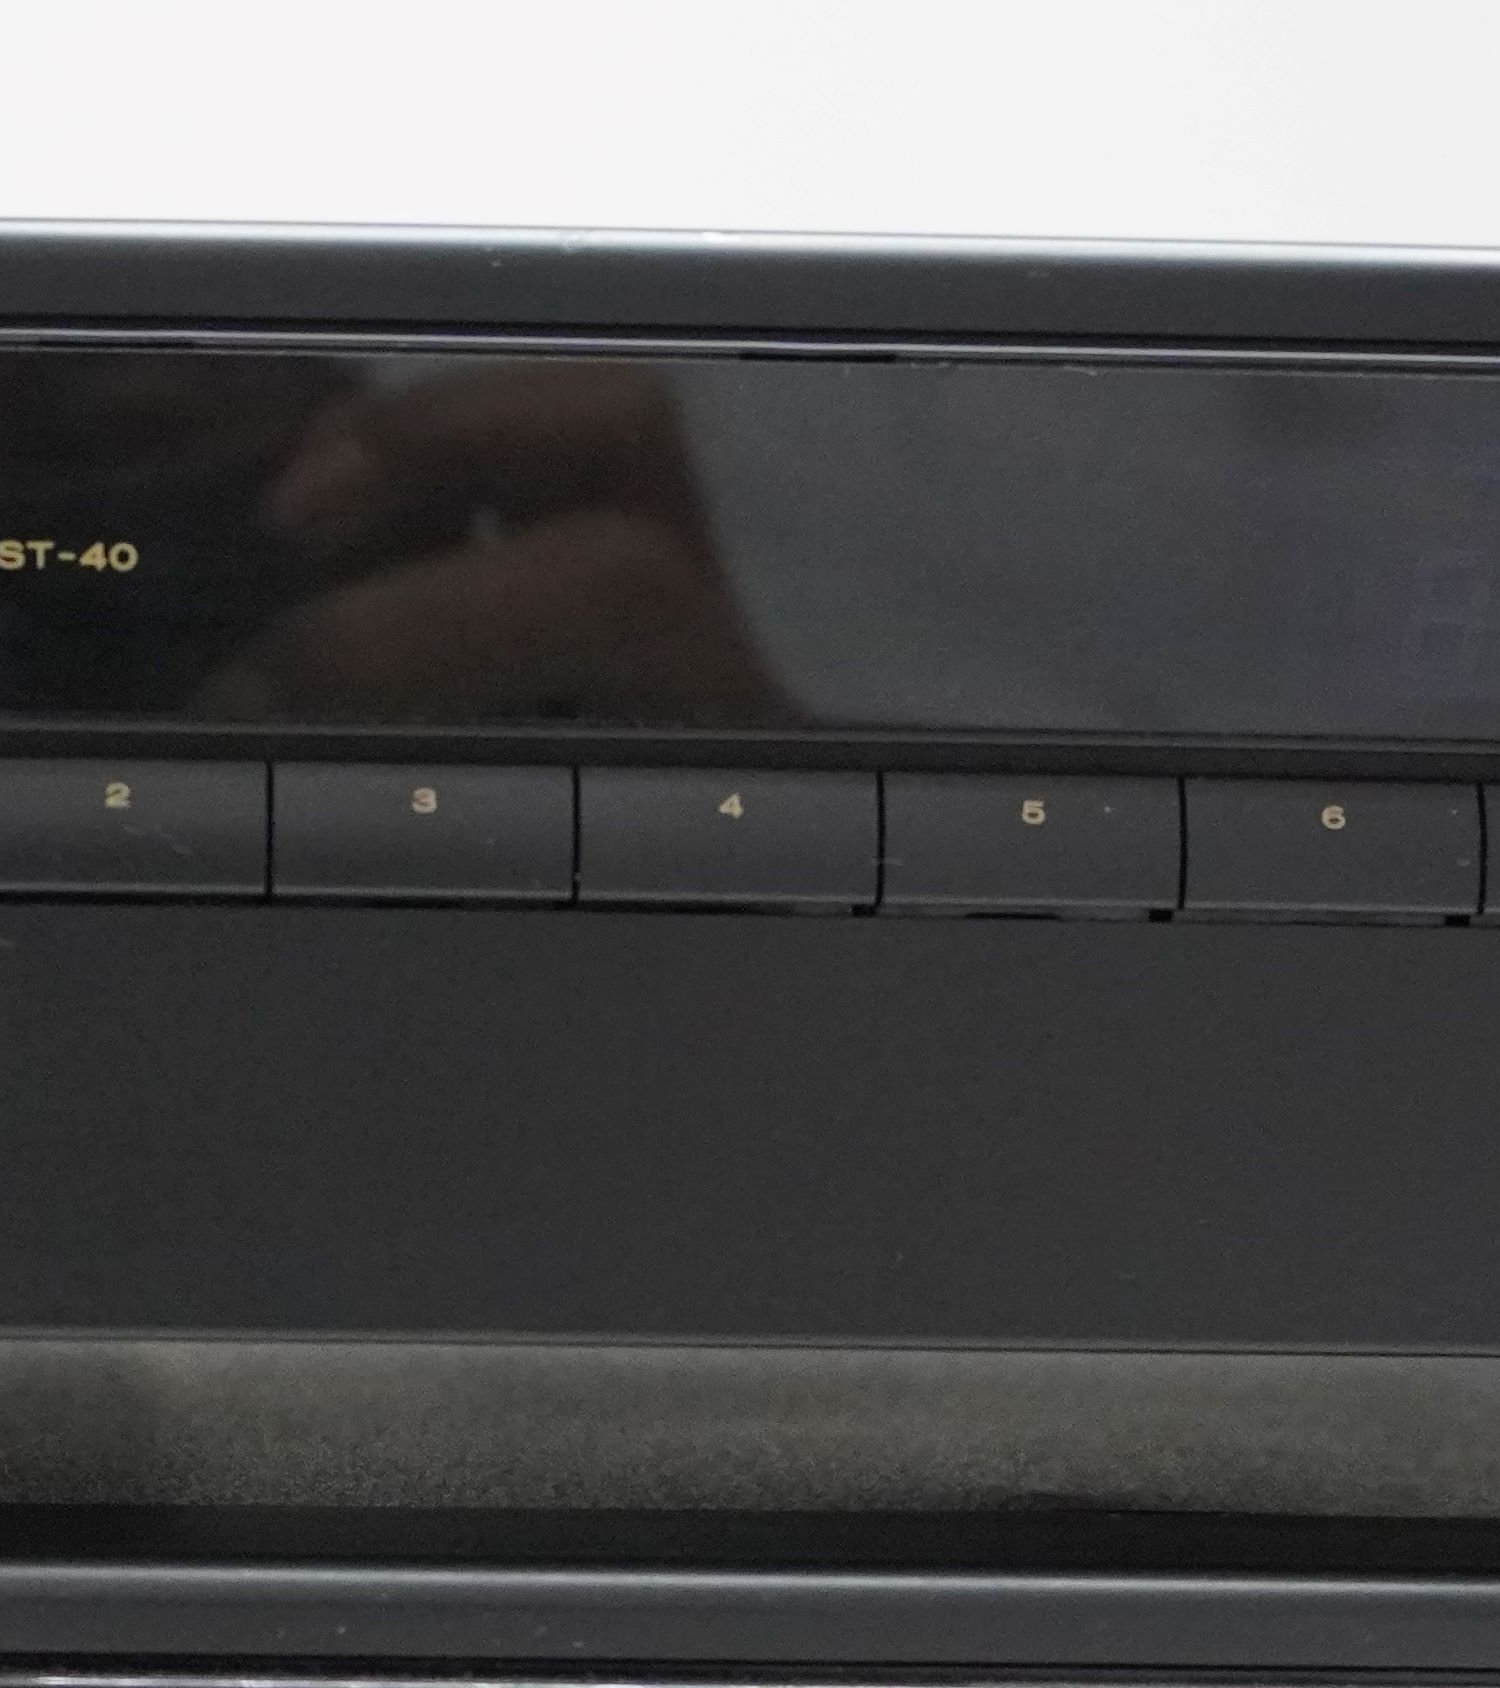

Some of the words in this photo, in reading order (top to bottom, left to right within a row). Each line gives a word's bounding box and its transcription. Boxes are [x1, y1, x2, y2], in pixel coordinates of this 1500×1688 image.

[105, 782, 131, 808] 2
[412, 787, 438, 814] 3
[718, 793, 744, 818] 4
[1021, 799, 1046, 825] 5
[1321, 805, 1346, 830] 6
